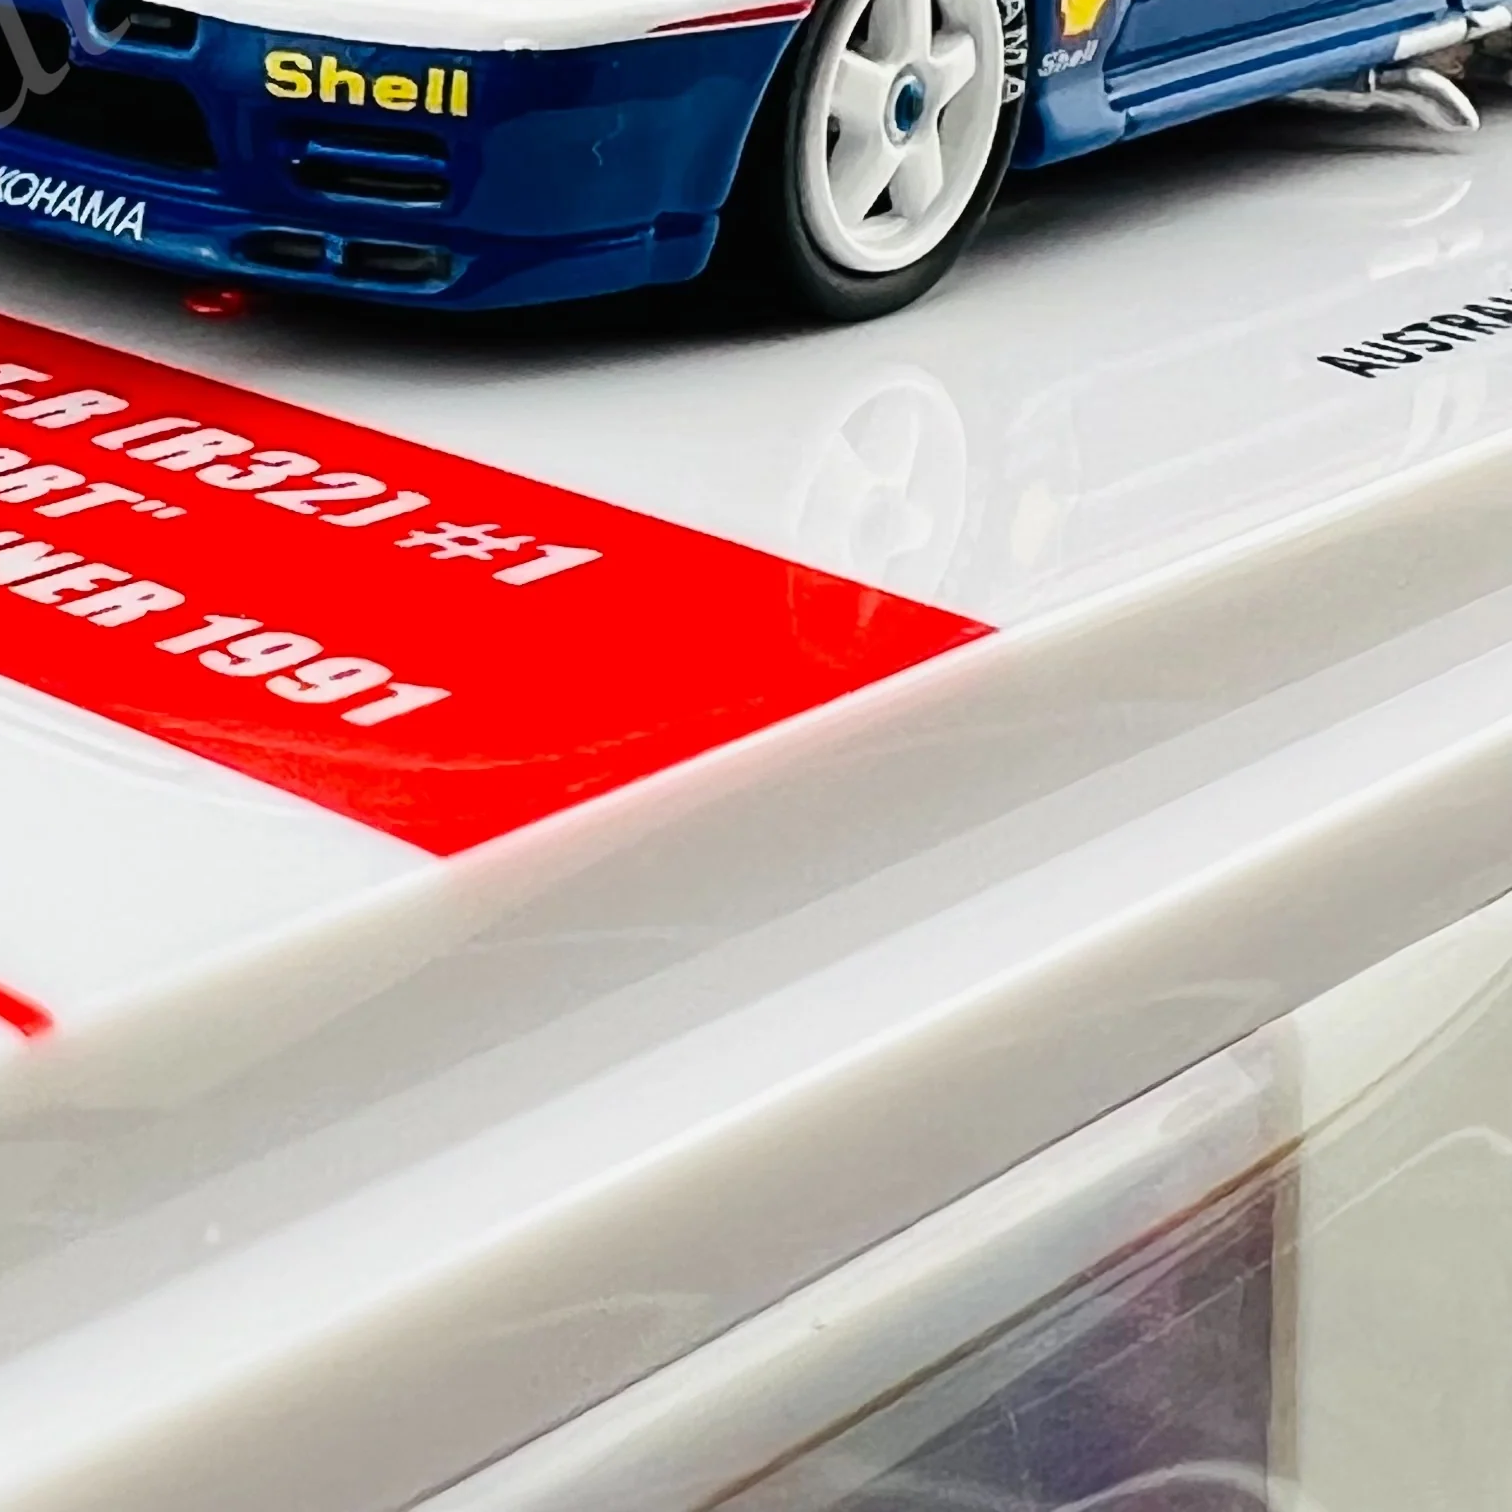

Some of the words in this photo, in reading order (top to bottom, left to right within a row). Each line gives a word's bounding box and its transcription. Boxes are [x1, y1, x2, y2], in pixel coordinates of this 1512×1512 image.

[264, 50, 471, 118] Shell
[394, 522, 603, 587] #1
[155, 613, 452, 727] 1991
